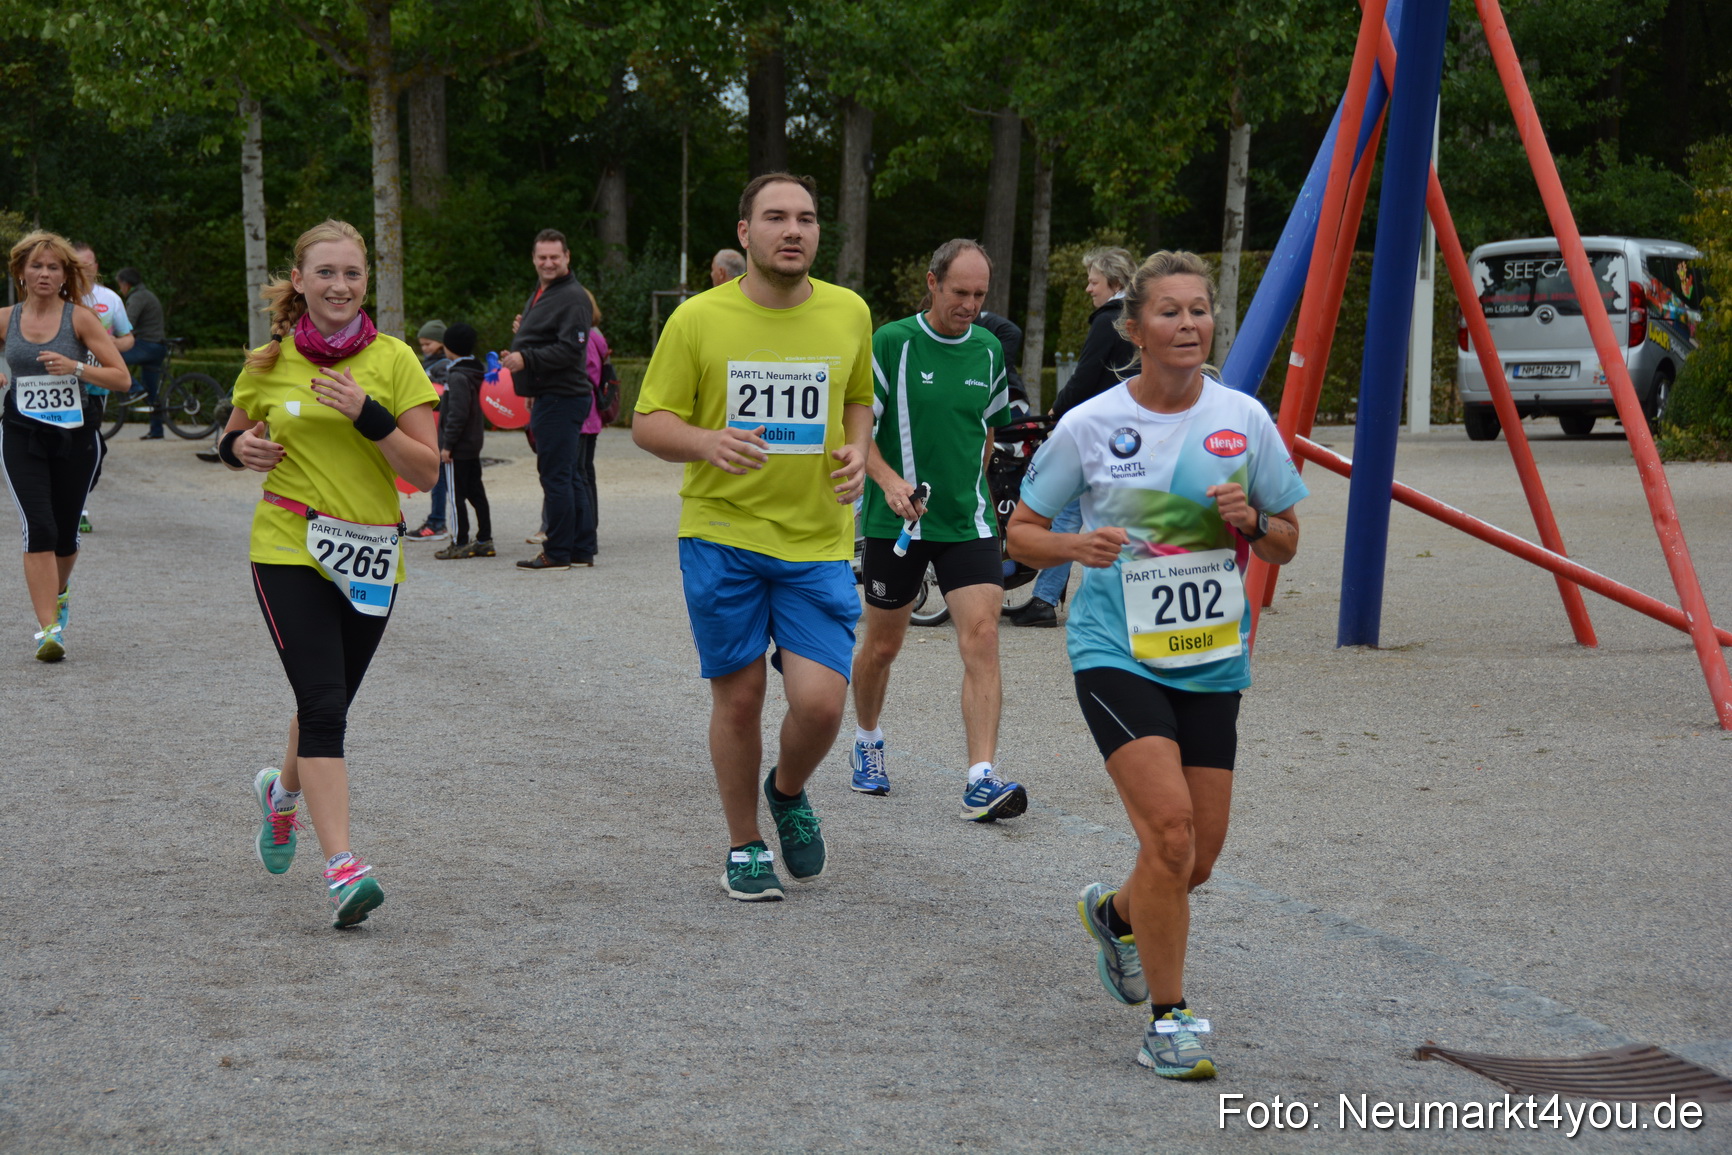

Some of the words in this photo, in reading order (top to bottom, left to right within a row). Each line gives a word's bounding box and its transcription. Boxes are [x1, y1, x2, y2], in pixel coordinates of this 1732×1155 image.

[730, 370, 764, 380] PARTL
[766, 371, 812, 381] Neumarkt
[1555, 365, 1567, 375] 22
[24, 388, 75, 410] 2333
[738, 384, 820, 420] 2110
[40, 414, 63, 422] Petra
[1209, 436, 1244, 450] Hervis
[1110, 461, 1145, 473] PARTL
[1111, 470, 1146, 480] Neumarkt
[311, 522, 343, 537] PARTL
[345, 530, 388, 544] Neumarkt
[316, 539, 392, 581] 2265
[1125, 568, 1166, 583] PARTL
[1168, 562, 1221, 578] Neumarkt
[1151, 579, 1225, 626] 202
[1168, 632, 1214, 652] Gisela
